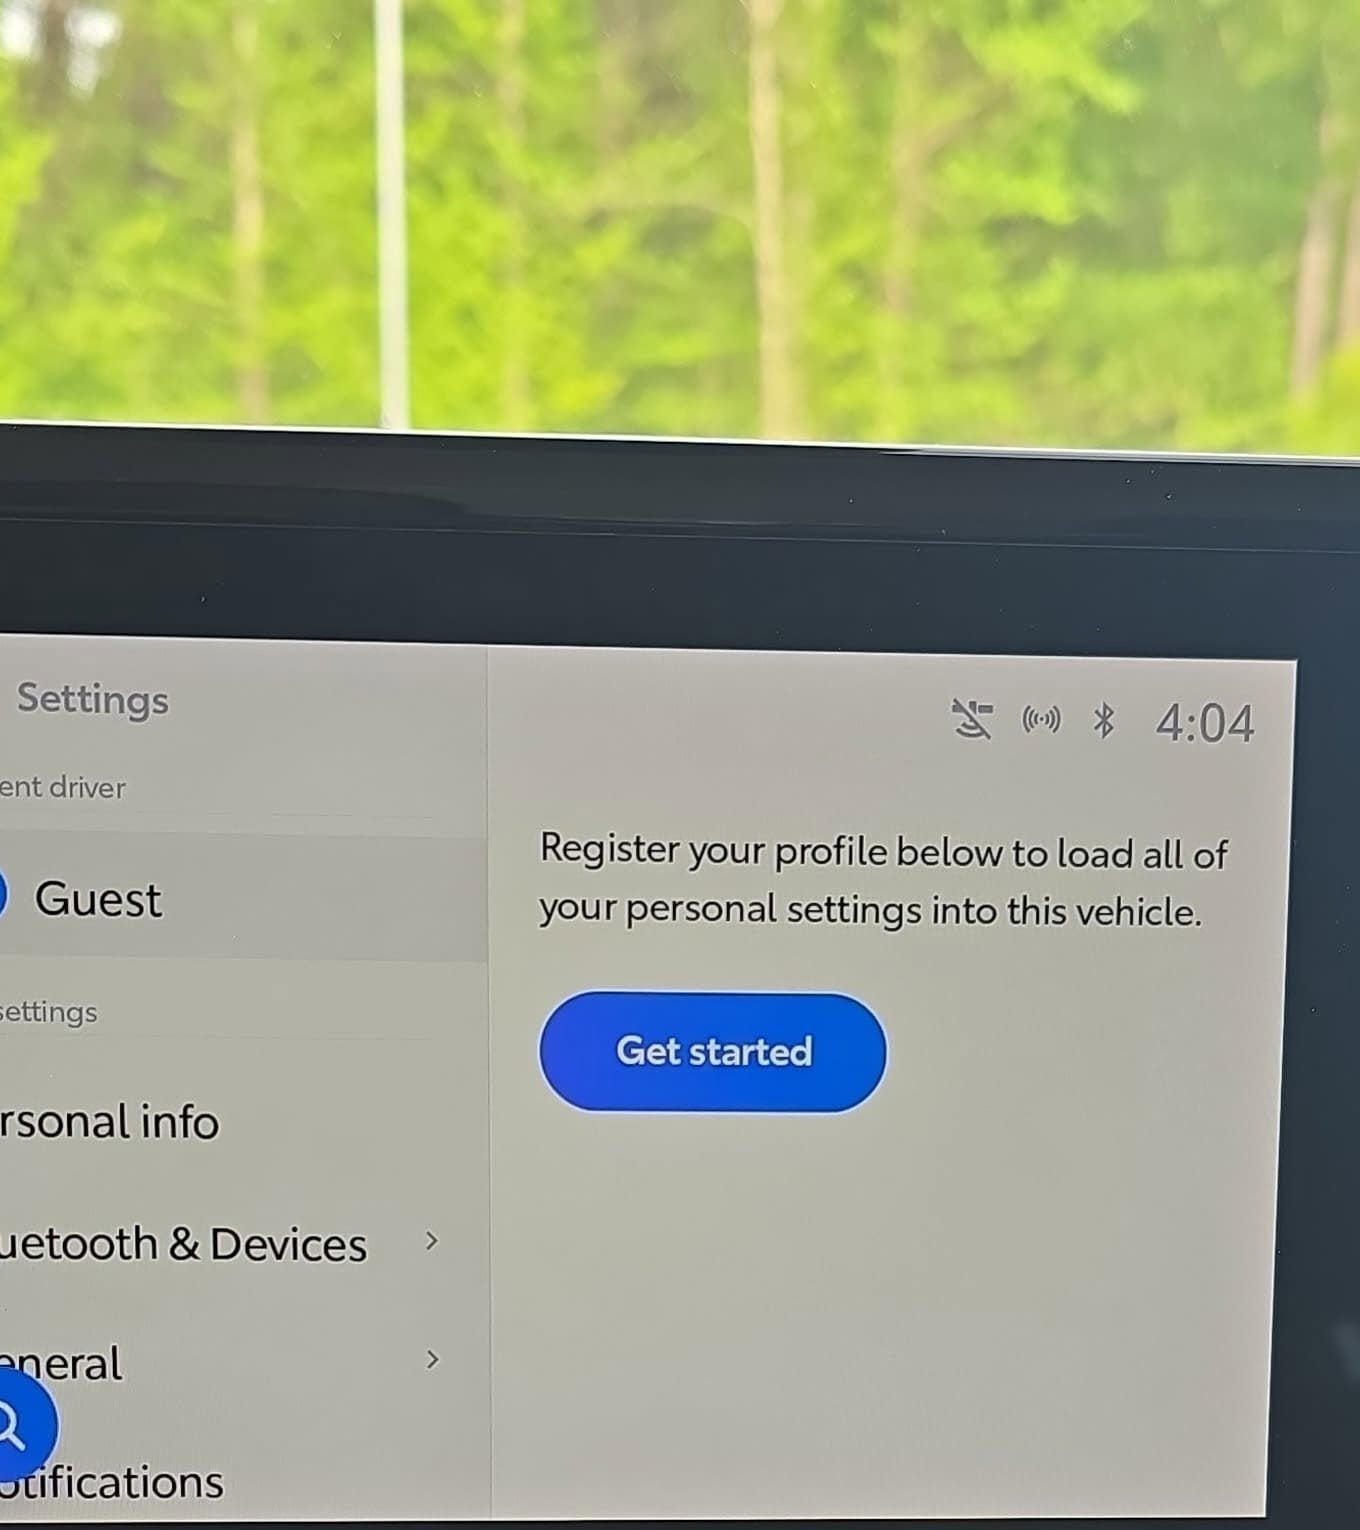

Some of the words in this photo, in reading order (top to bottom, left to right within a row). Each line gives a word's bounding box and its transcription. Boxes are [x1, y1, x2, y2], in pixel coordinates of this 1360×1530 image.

[18, 681, 169, 723] Settings
[1156, 702, 1255, 743] 4:04
[49, 773, 127, 799] driver
[542, 831, 681, 870] Register
[688, 842, 766, 872] your
[776, 834, 888, 873] profile
[897, 835, 1004, 867] below
[1012, 840, 1049, 868] to
[1058, 837, 1133, 869] load
[1143, 838, 1184, 869] all
[1194, 839, 1229, 870] of
[36, 880, 163, 918] Guest
[539, 898, 618, 928] your
[627, 891, 778, 930] personal
[787, 896, 922, 932] settings
[933, 894, 997, 925] into
[1007, 894, 1067, 925] this
[1076, 895, 1201, 927] vehicle.
[617, 1035, 682, 1065] Get
[689, 1035, 812, 1067] started
[142, 1103, 219, 1140] info
[169, 1226, 201, 1261] &
[212, 1226, 367, 1262] Devices
